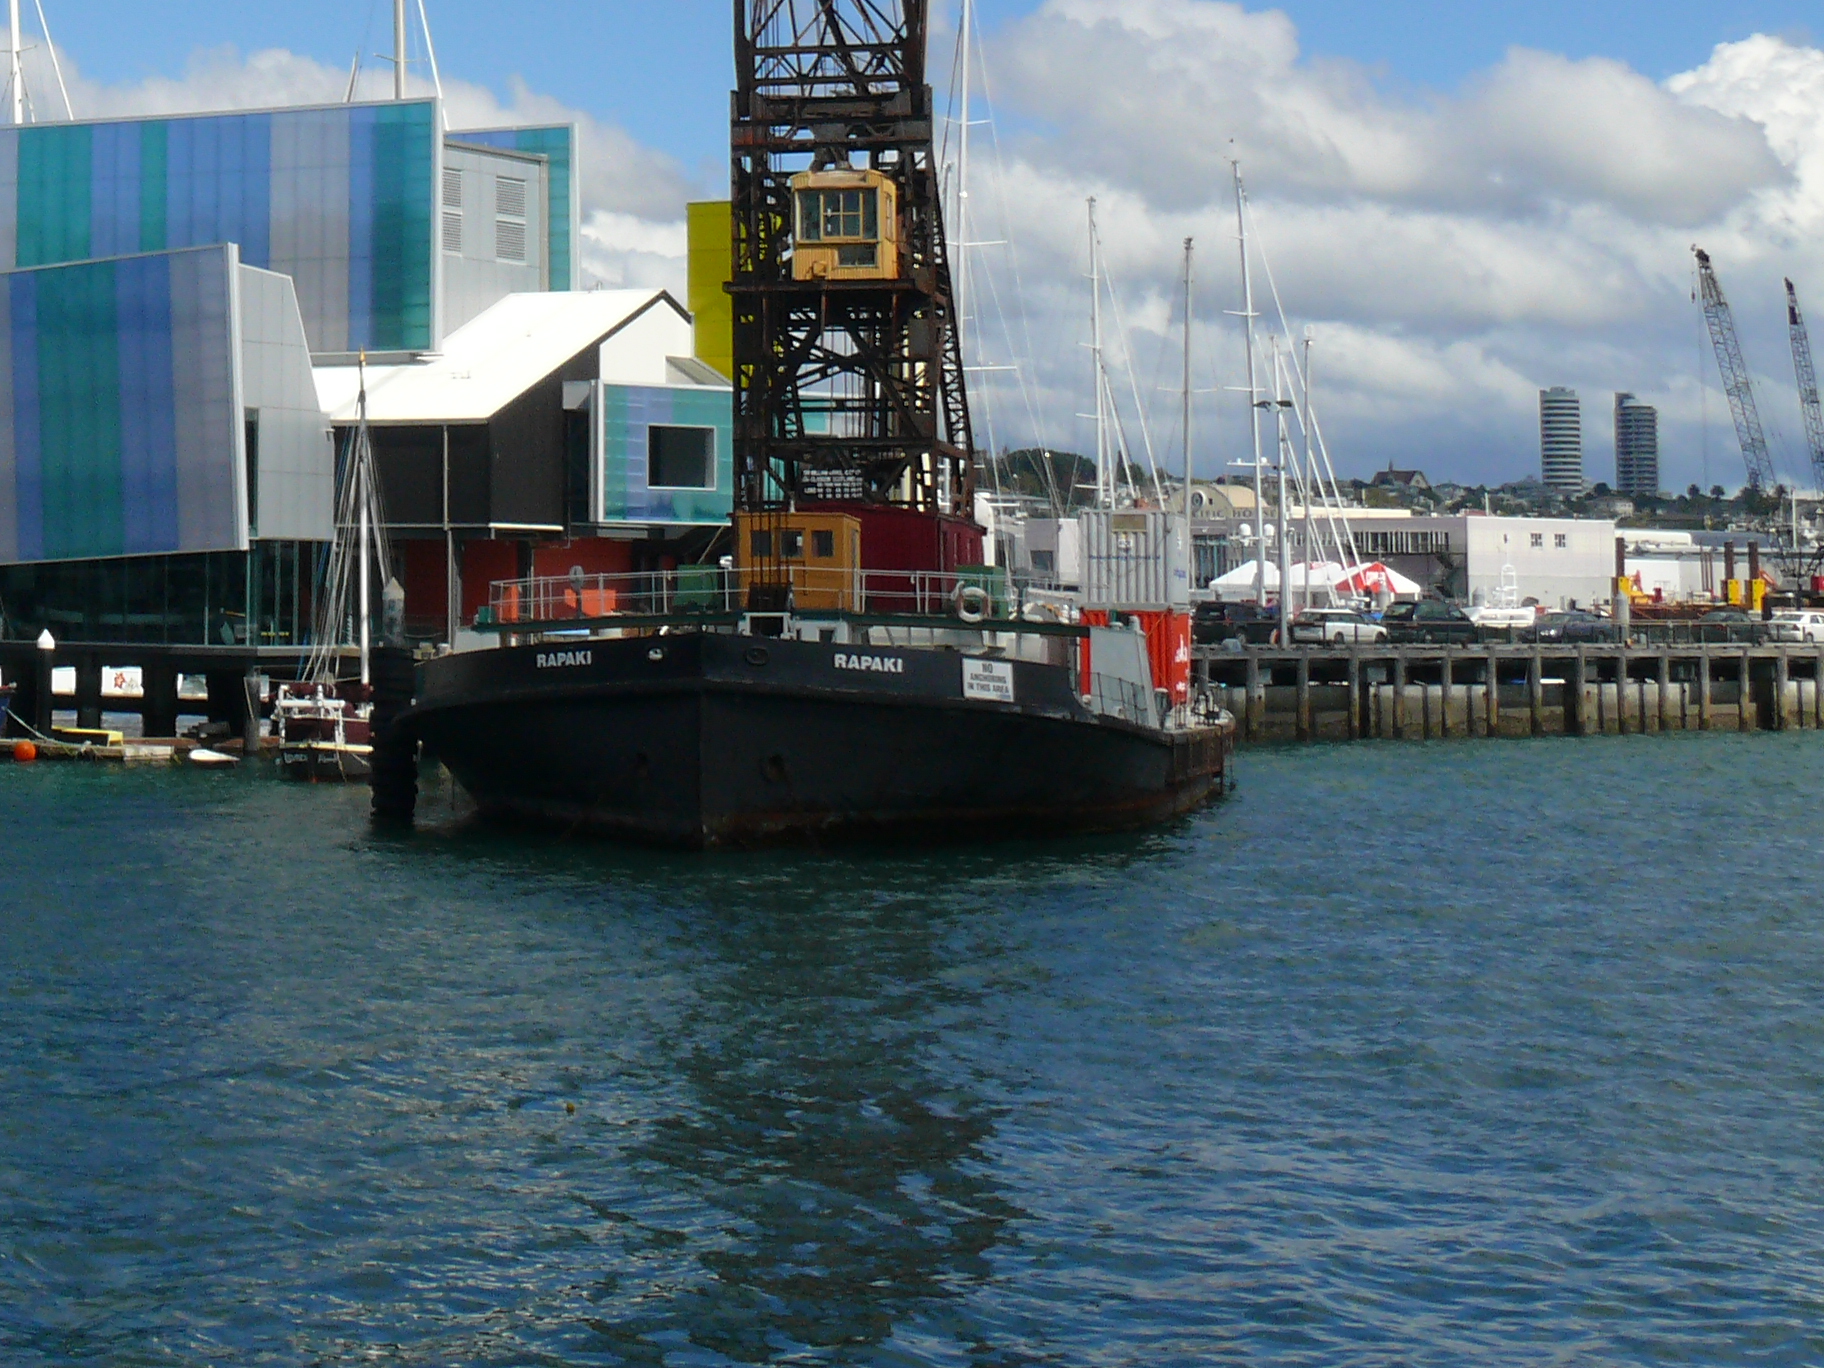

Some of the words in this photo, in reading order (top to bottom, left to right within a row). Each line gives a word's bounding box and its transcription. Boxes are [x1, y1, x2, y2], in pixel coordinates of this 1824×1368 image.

[536, 650, 592, 668] RAPAKI
[834, 653, 904, 673] RAPAKI
[982, 663, 993, 674] NO
[977, 683, 991, 692] THIS
